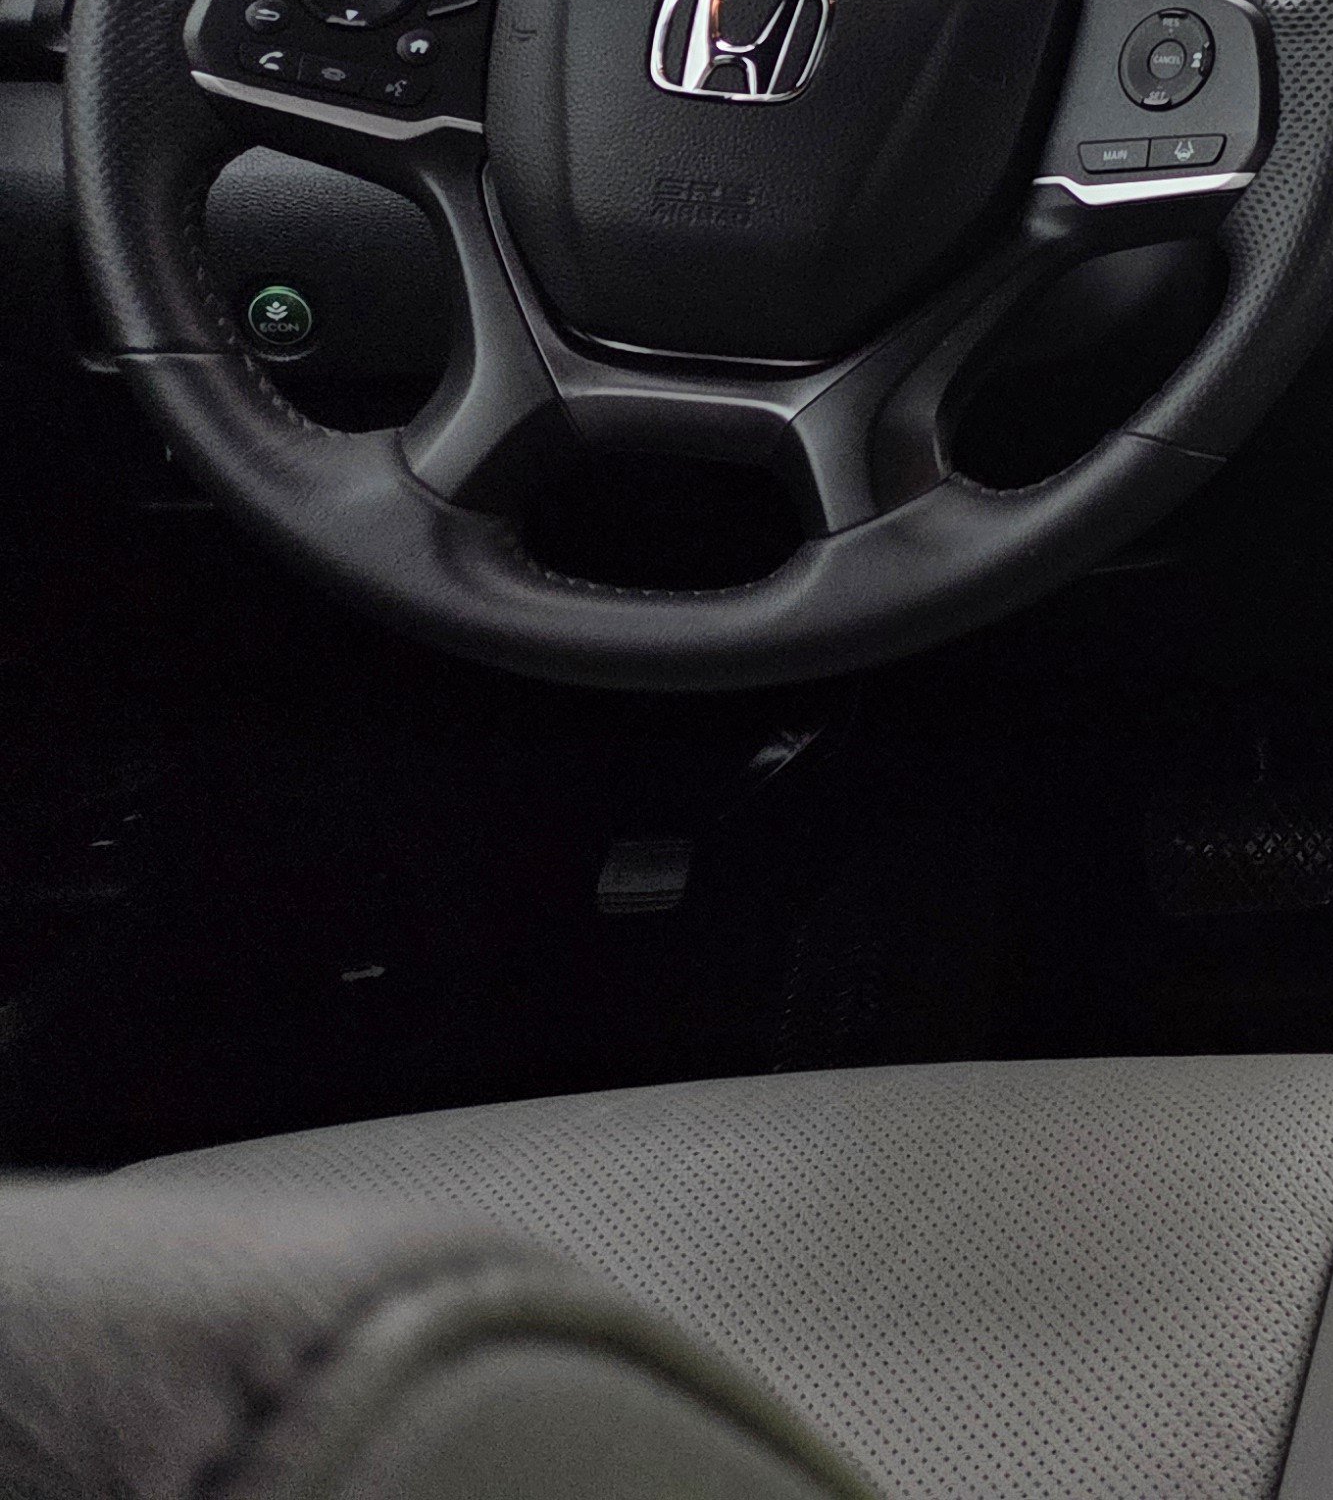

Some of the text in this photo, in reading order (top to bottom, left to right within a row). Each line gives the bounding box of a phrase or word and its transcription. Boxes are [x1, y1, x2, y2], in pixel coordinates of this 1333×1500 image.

[1153, 54, 1182, 65] CANCEL
[1103, 150, 1128, 161] MAIN
[259, 322, 300, 332] ECON
